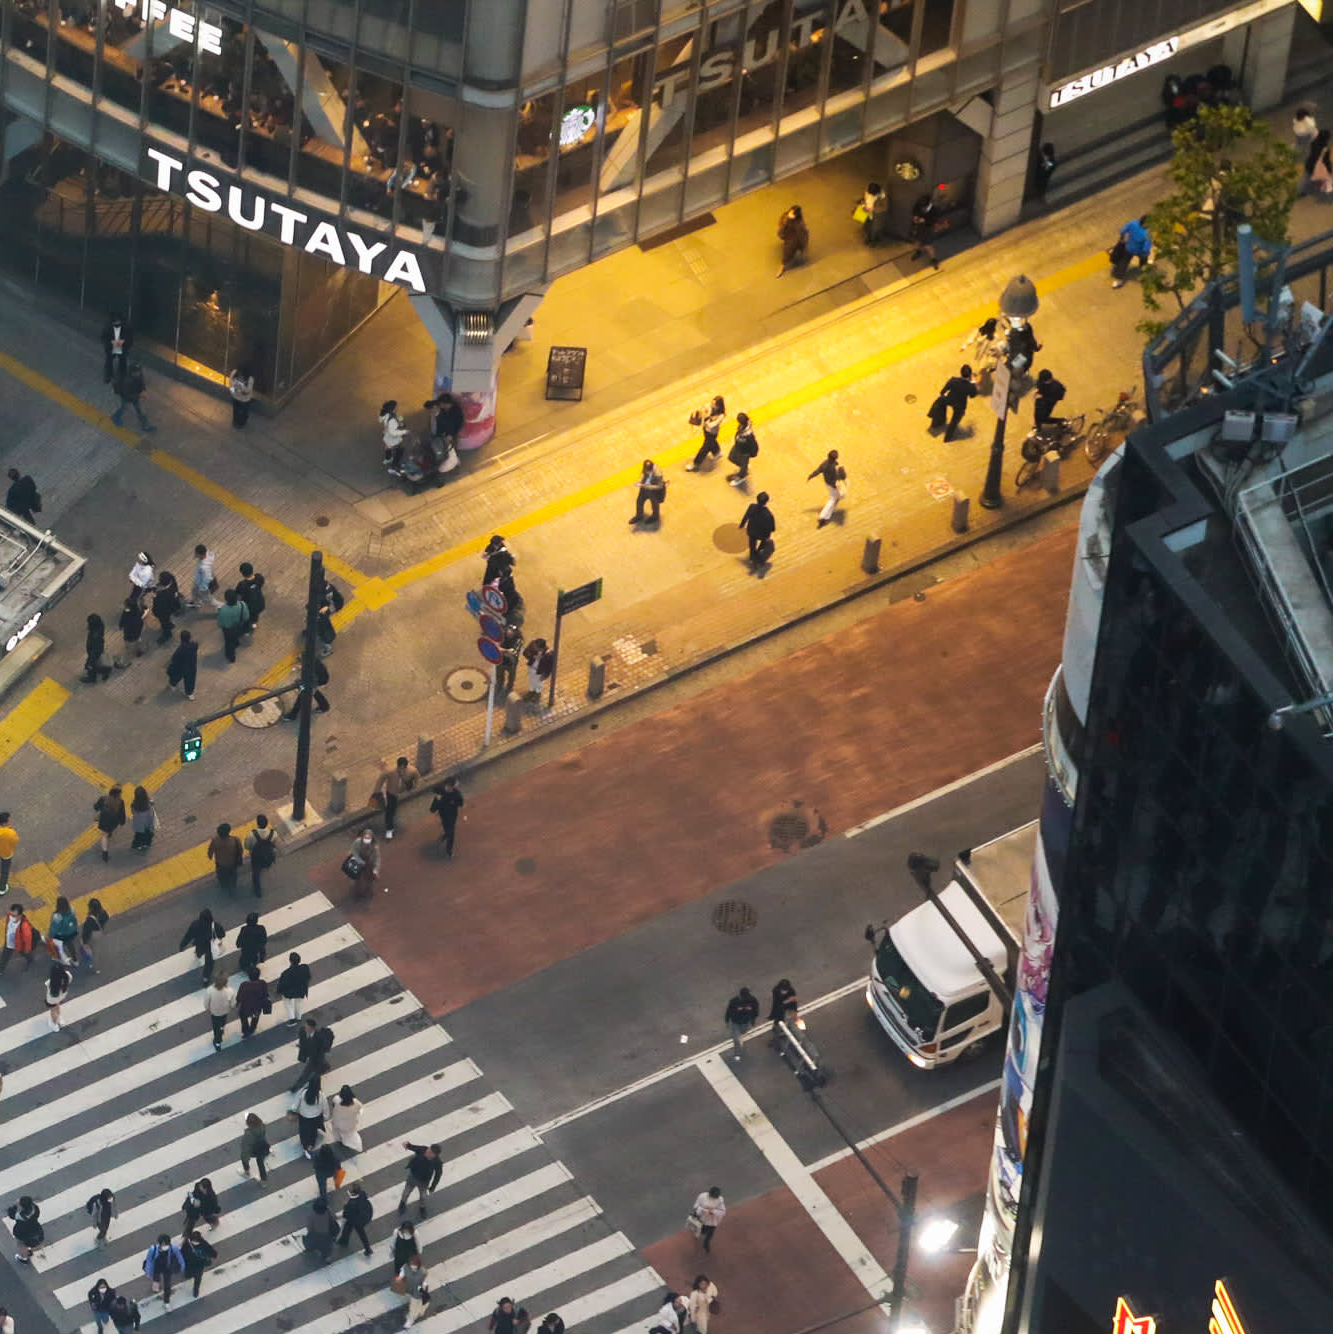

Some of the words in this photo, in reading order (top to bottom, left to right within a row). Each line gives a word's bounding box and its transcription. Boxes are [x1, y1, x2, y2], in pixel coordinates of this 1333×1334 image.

[653, 0, 903, 108] TSUTA
[1050, 38, 1176, 104] TSUTAYA
[147, 147, 427, 294] TSUTAYA
